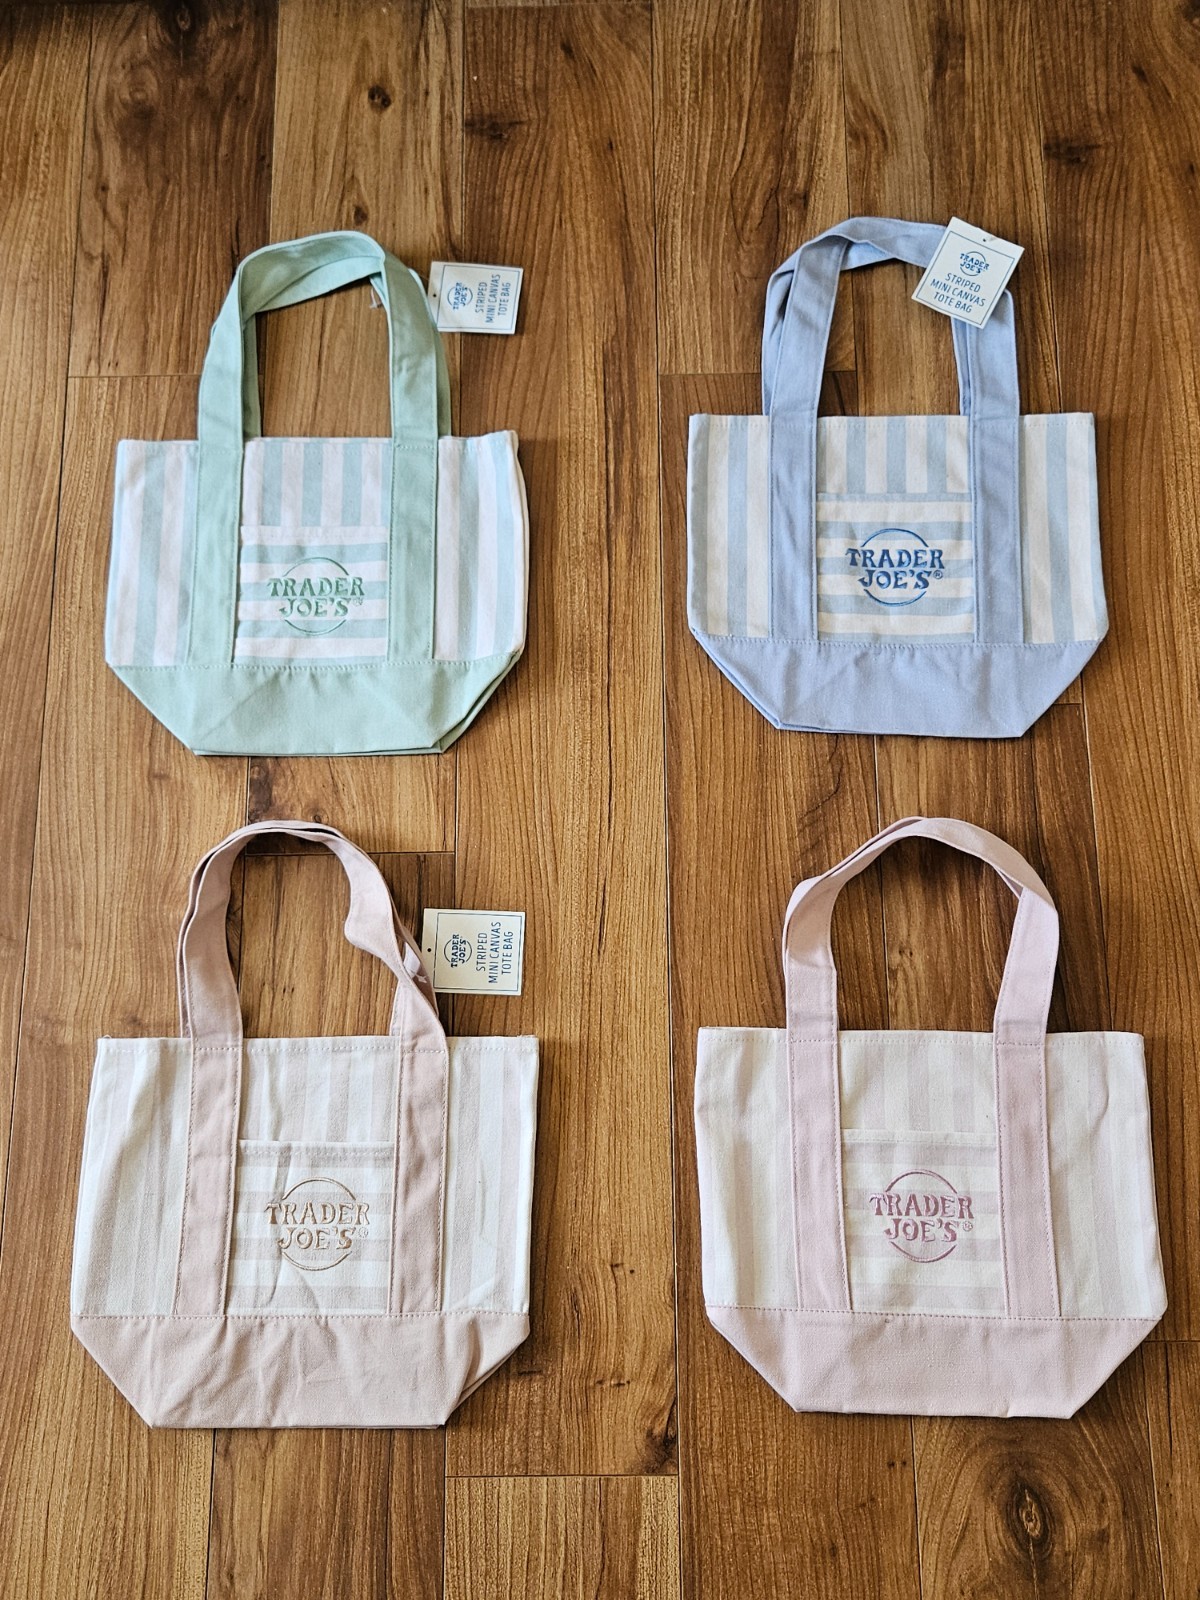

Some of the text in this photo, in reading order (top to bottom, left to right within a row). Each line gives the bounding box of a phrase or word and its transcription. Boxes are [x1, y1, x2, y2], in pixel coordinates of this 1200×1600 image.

[960, 253, 989, 270] TRADER
[453, 282, 462, 310] TRADER
[930, 278, 986, 307] MINI CANVAS
[945, 272, 981, 293] STRIPED
[475, 281, 487, 313] STRIPED
[485, 274, 501, 323] MINI CANVAS
[497, 282, 511, 316] TOTE BAG
[933, 291, 973, 314] TOTE BAG
[845, 548, 945, 569] TRADER
[266, 576, 365, 597] TRADER
[450, 933, 460, 968] TRADER
[458, 938, 467, 964] JOE'S
[476, 932, 488, 972] STRIPED
[488, 921, 502, 984] MINI CANVAS
[501, 931, 514, 975] TOTE BAG
[264, 1201, 370, 1225] TRADER
[869, 1192, 974, 1219] TRADER
